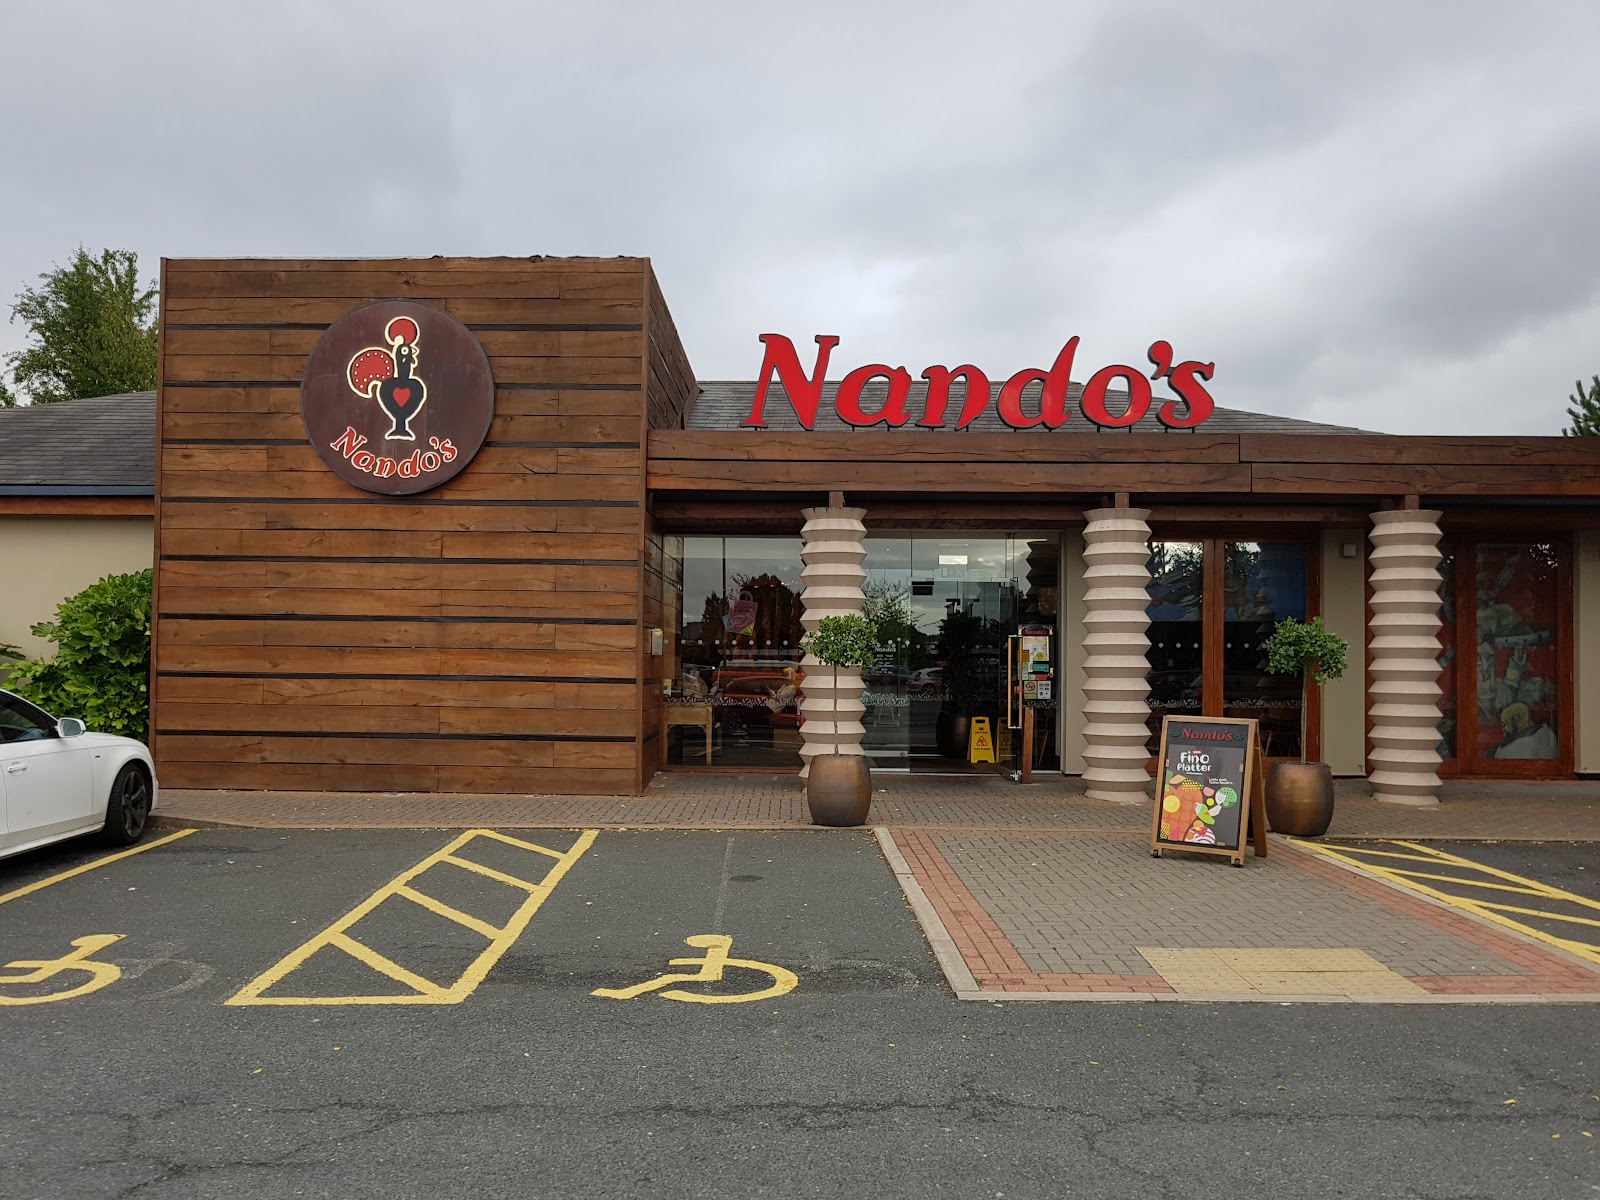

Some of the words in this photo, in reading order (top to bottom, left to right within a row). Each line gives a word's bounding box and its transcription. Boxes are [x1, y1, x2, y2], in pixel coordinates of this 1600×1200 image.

[740, 333, 1215, 431] Nando's
[330, 426, 457, 478] Nando's
[1181, 728, 1233, 741] Nando's
[1180, 750, 1210, 764] Fino
[1177, 763, 1212, 772] Platter
